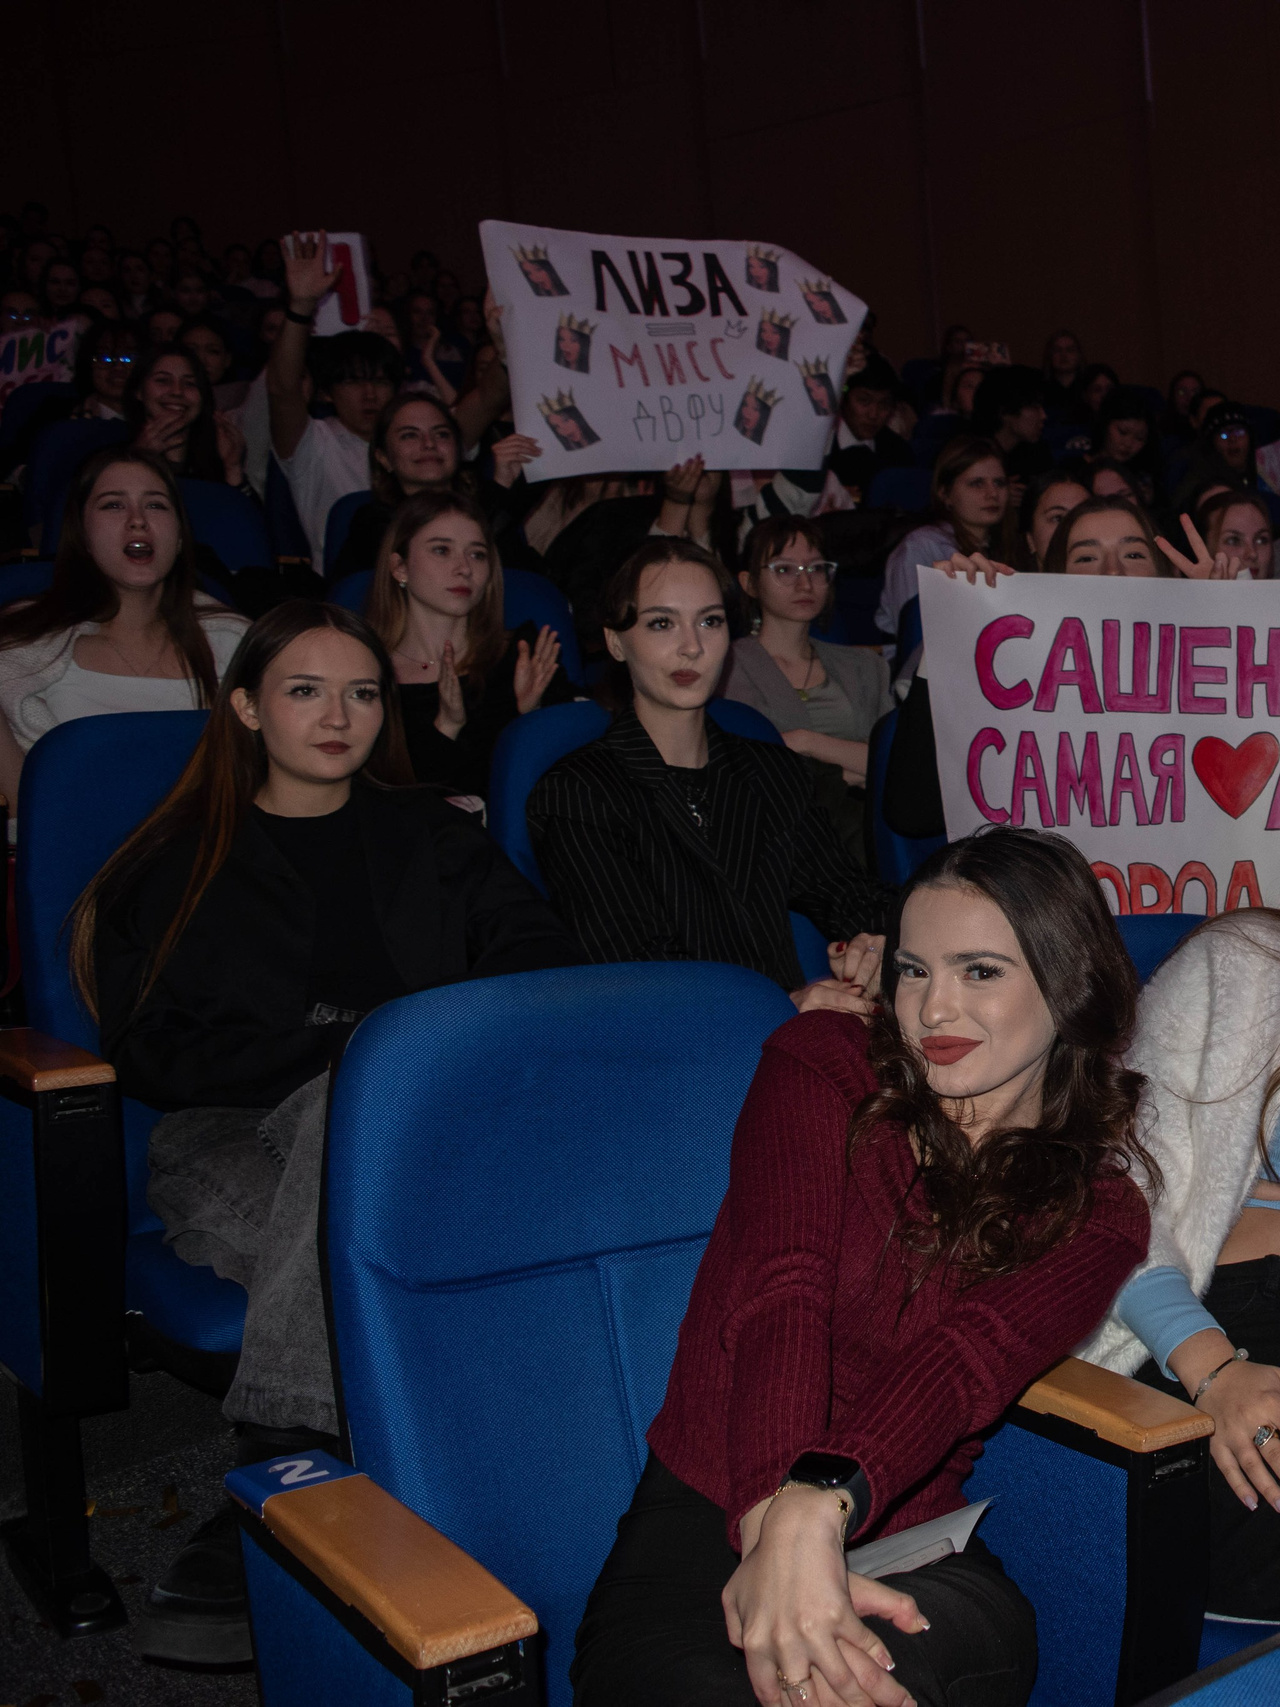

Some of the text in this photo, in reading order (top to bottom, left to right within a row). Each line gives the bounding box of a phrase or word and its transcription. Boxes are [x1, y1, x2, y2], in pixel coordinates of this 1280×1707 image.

[591, 250, 749, 317] ЛИЗА
[608, 338, 735, 388] МИСС
[632, 393, 725, 442] ДВФУ
[967, 727, 1186, 828] САМАЯ
[269, 1459, 330, 1485] 2
